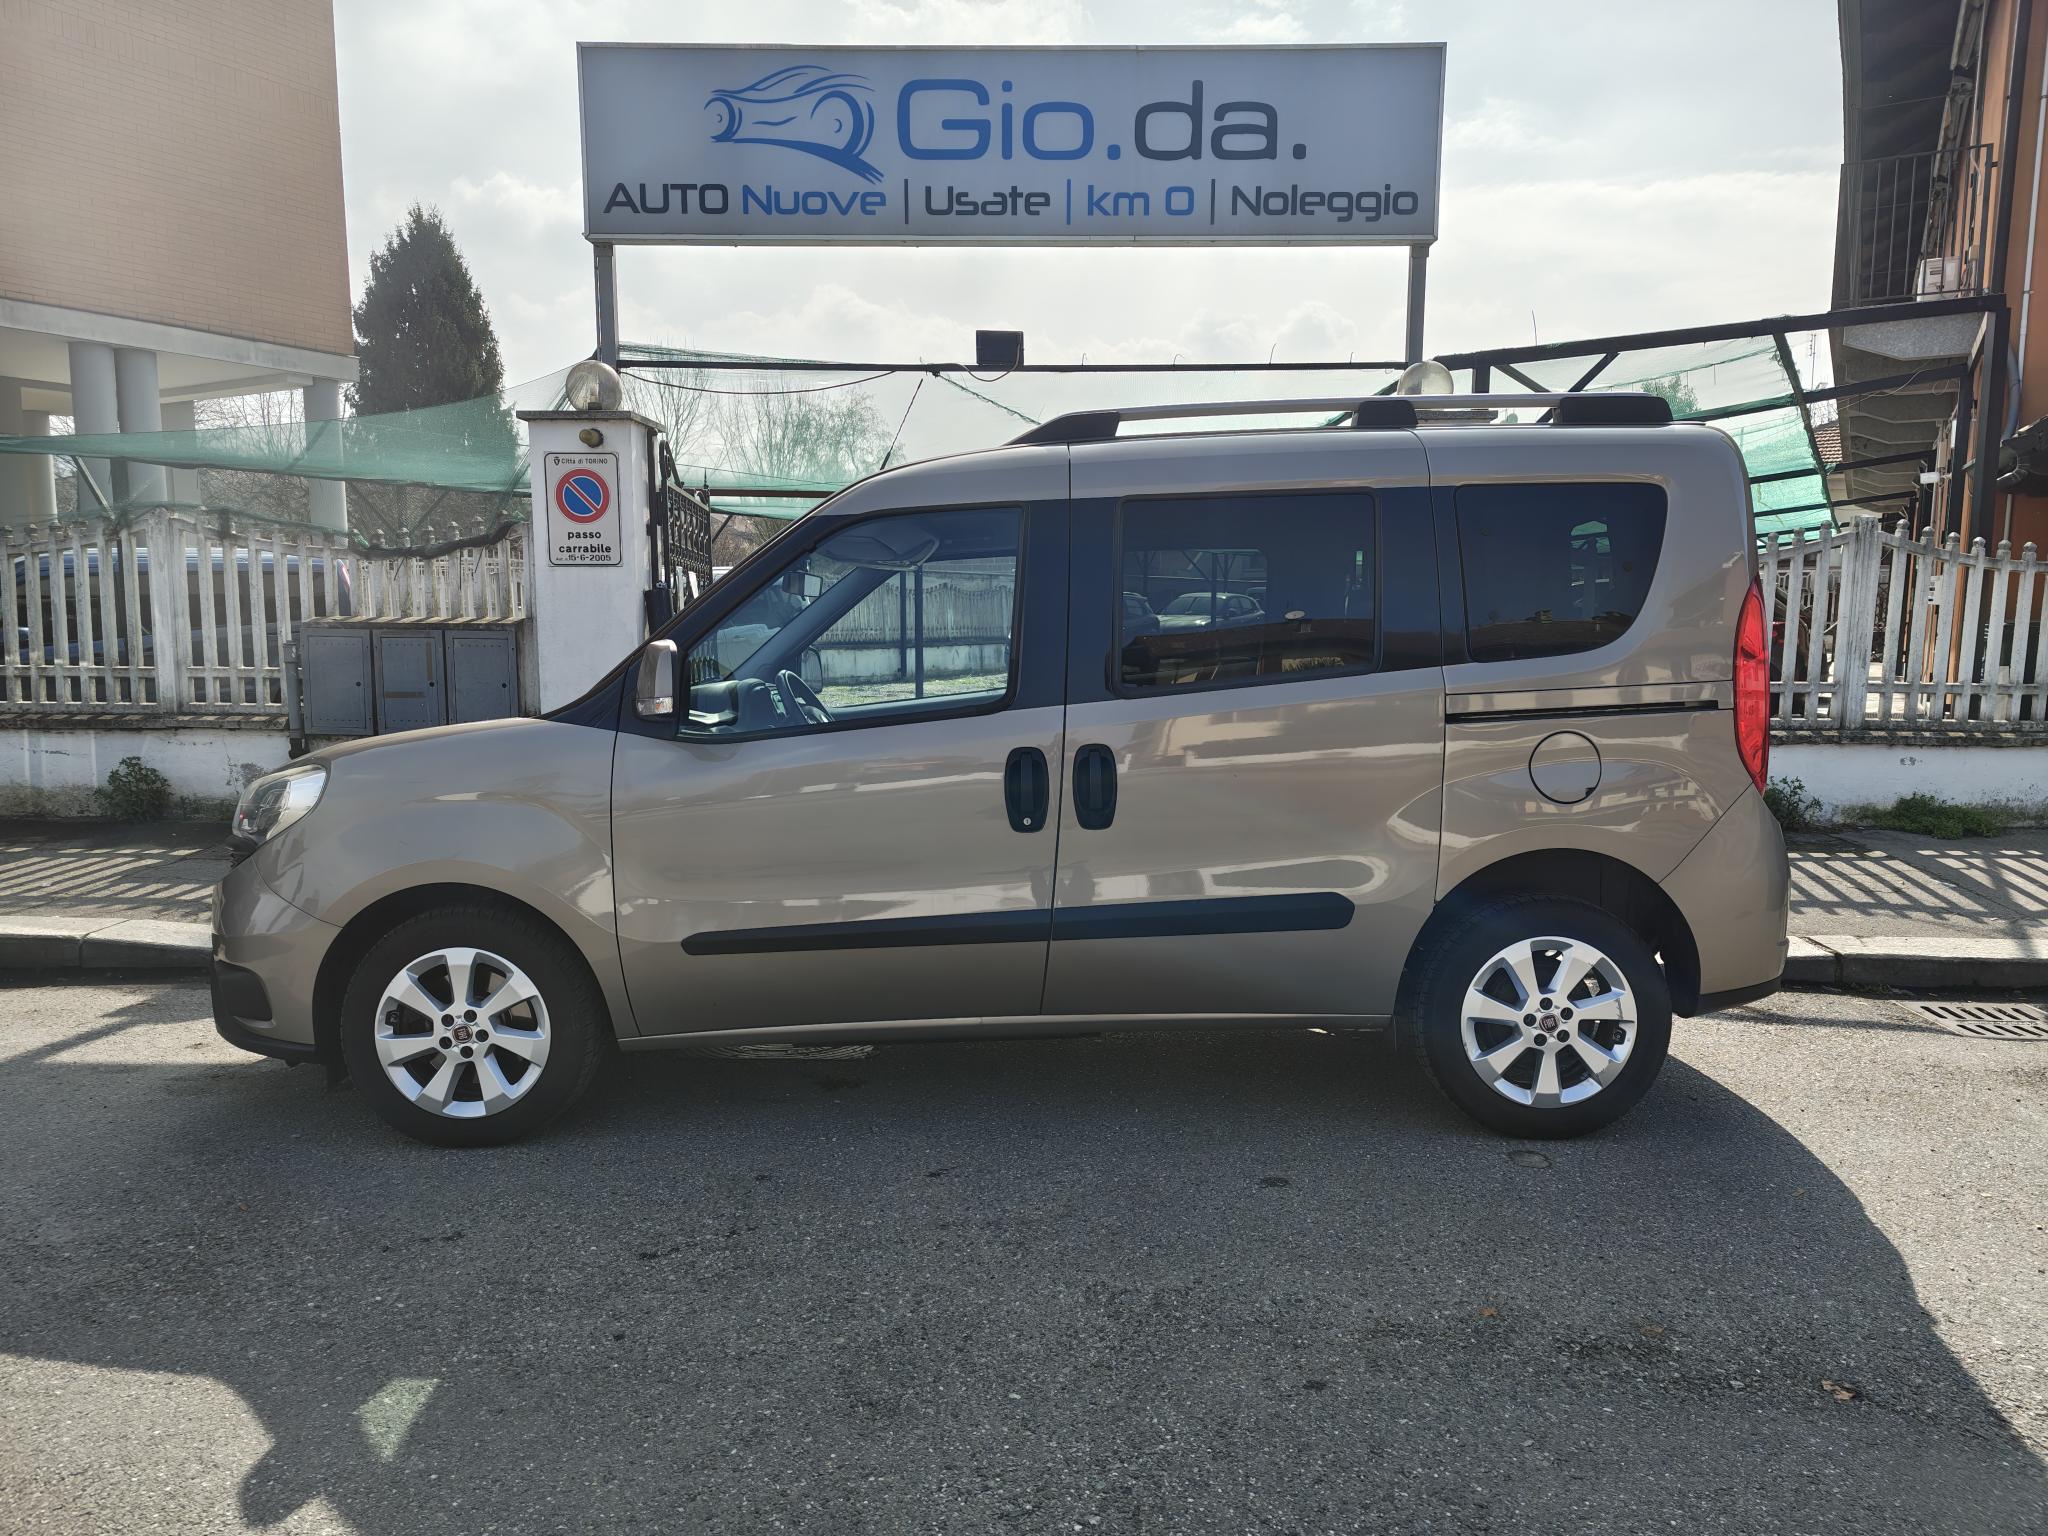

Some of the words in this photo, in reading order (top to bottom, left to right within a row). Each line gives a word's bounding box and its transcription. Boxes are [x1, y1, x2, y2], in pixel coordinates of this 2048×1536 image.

[603, 182, 729, 215] AUTO
[742, 184, 886, 216] Nuove
[924, 185, 1051, 216] Usate
[1087, 184, 1150, 217] km
[1231, 183, 1419, 223] Noleggio
[567, 531, 602, 540] passo
[559, 544, 612, 553] carrabile
